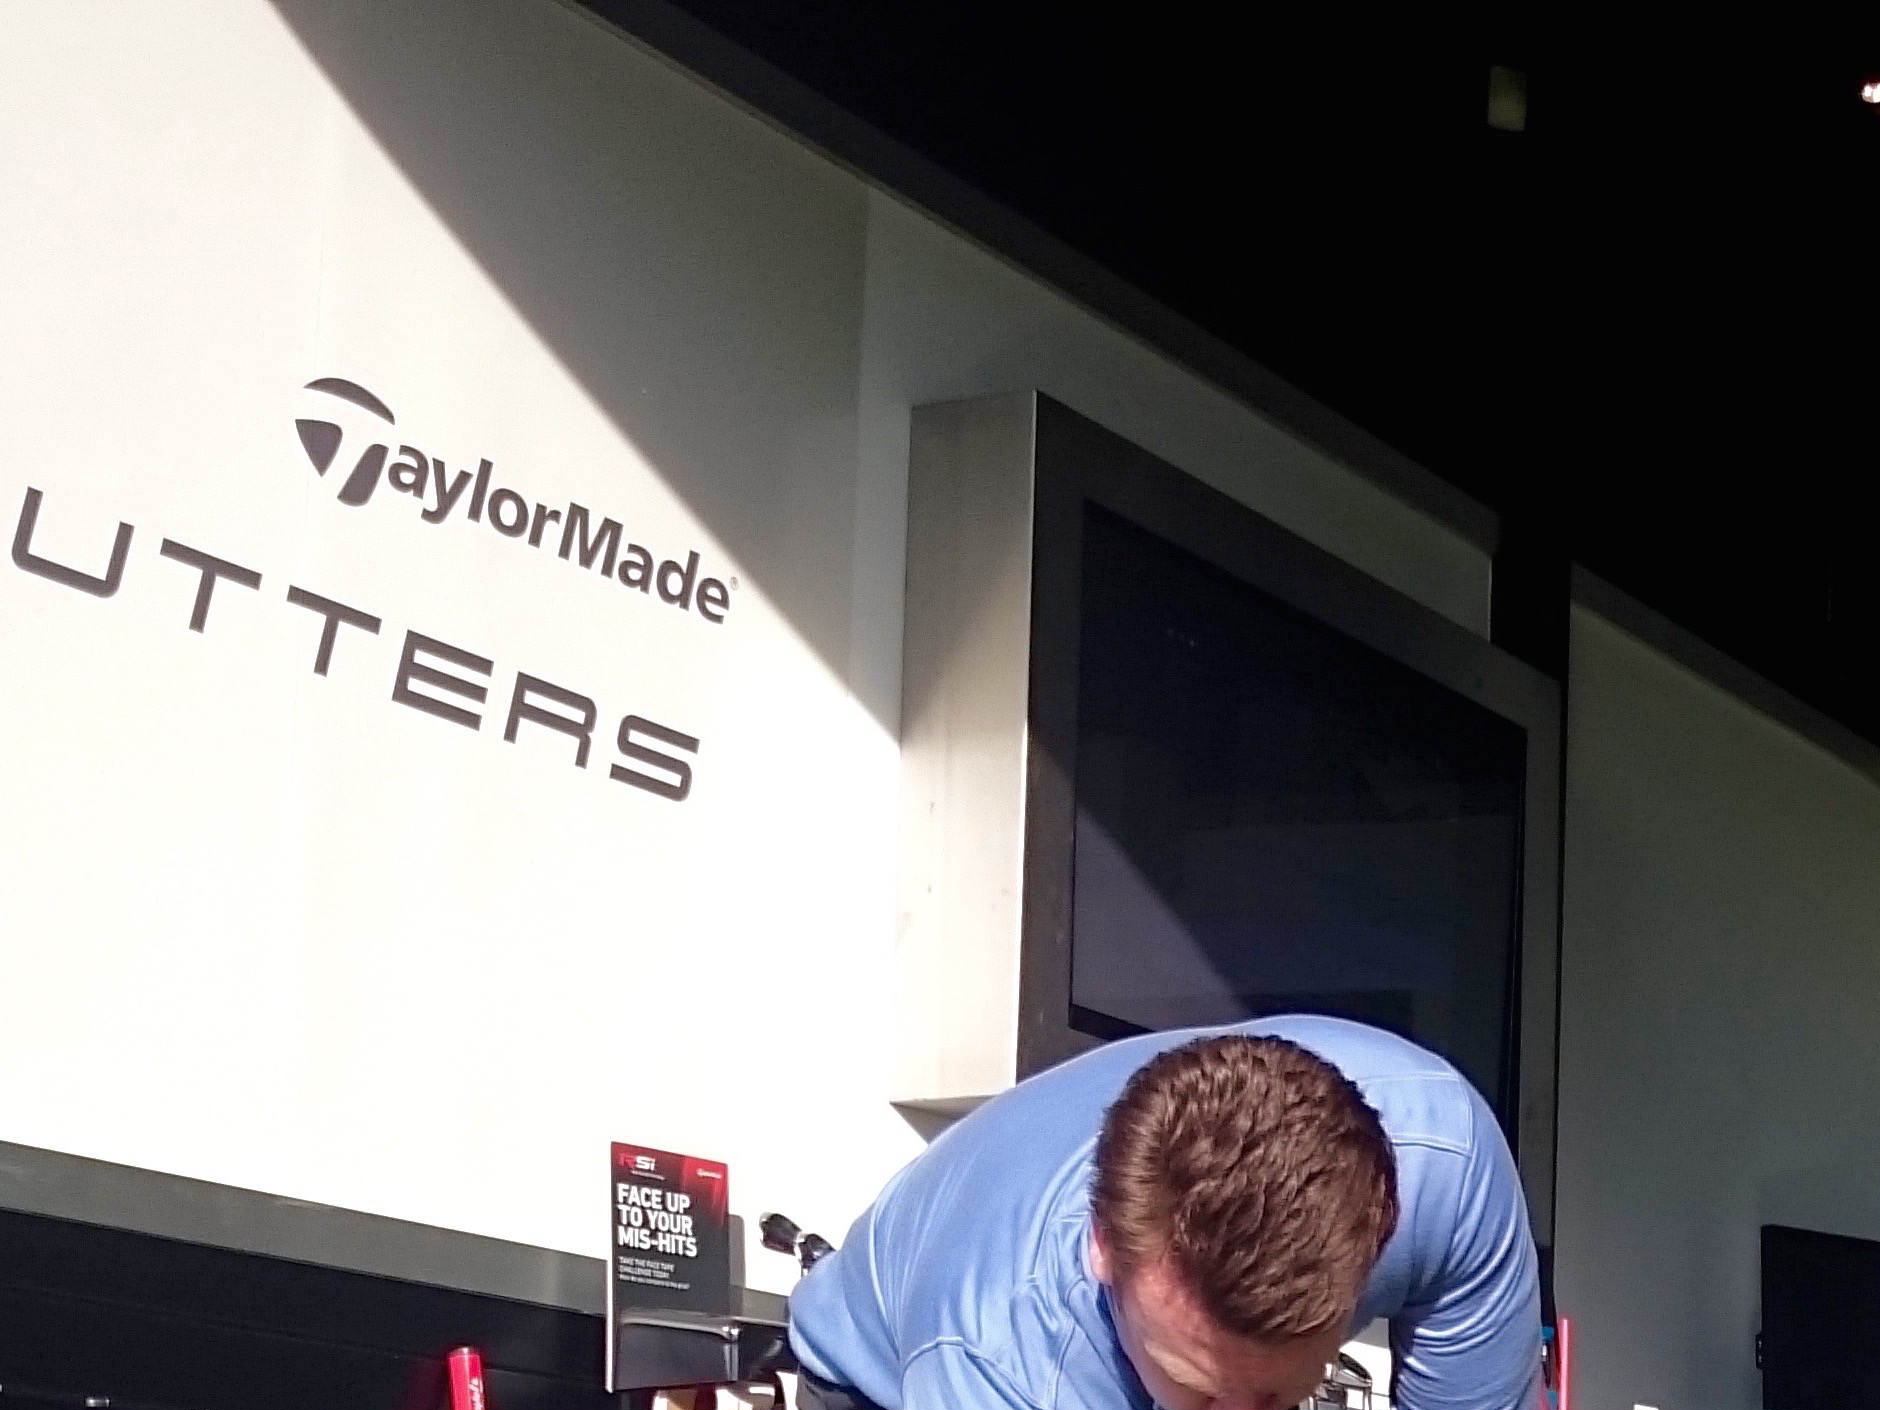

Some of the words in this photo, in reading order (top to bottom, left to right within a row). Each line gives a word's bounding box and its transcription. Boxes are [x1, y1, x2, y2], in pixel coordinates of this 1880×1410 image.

[295, 377, 731, 626] TaylorMade
[10, 485, 701, 803] UTTERS
[617, 1182, 663, 1210] FACE
[666, 1191, 691, 1214] UP
[617, 1204, 643, 1227] TO
[646, 1209, 693, 1236] YOUR
[618, 1225, 698, 1258] MIS-HITS
